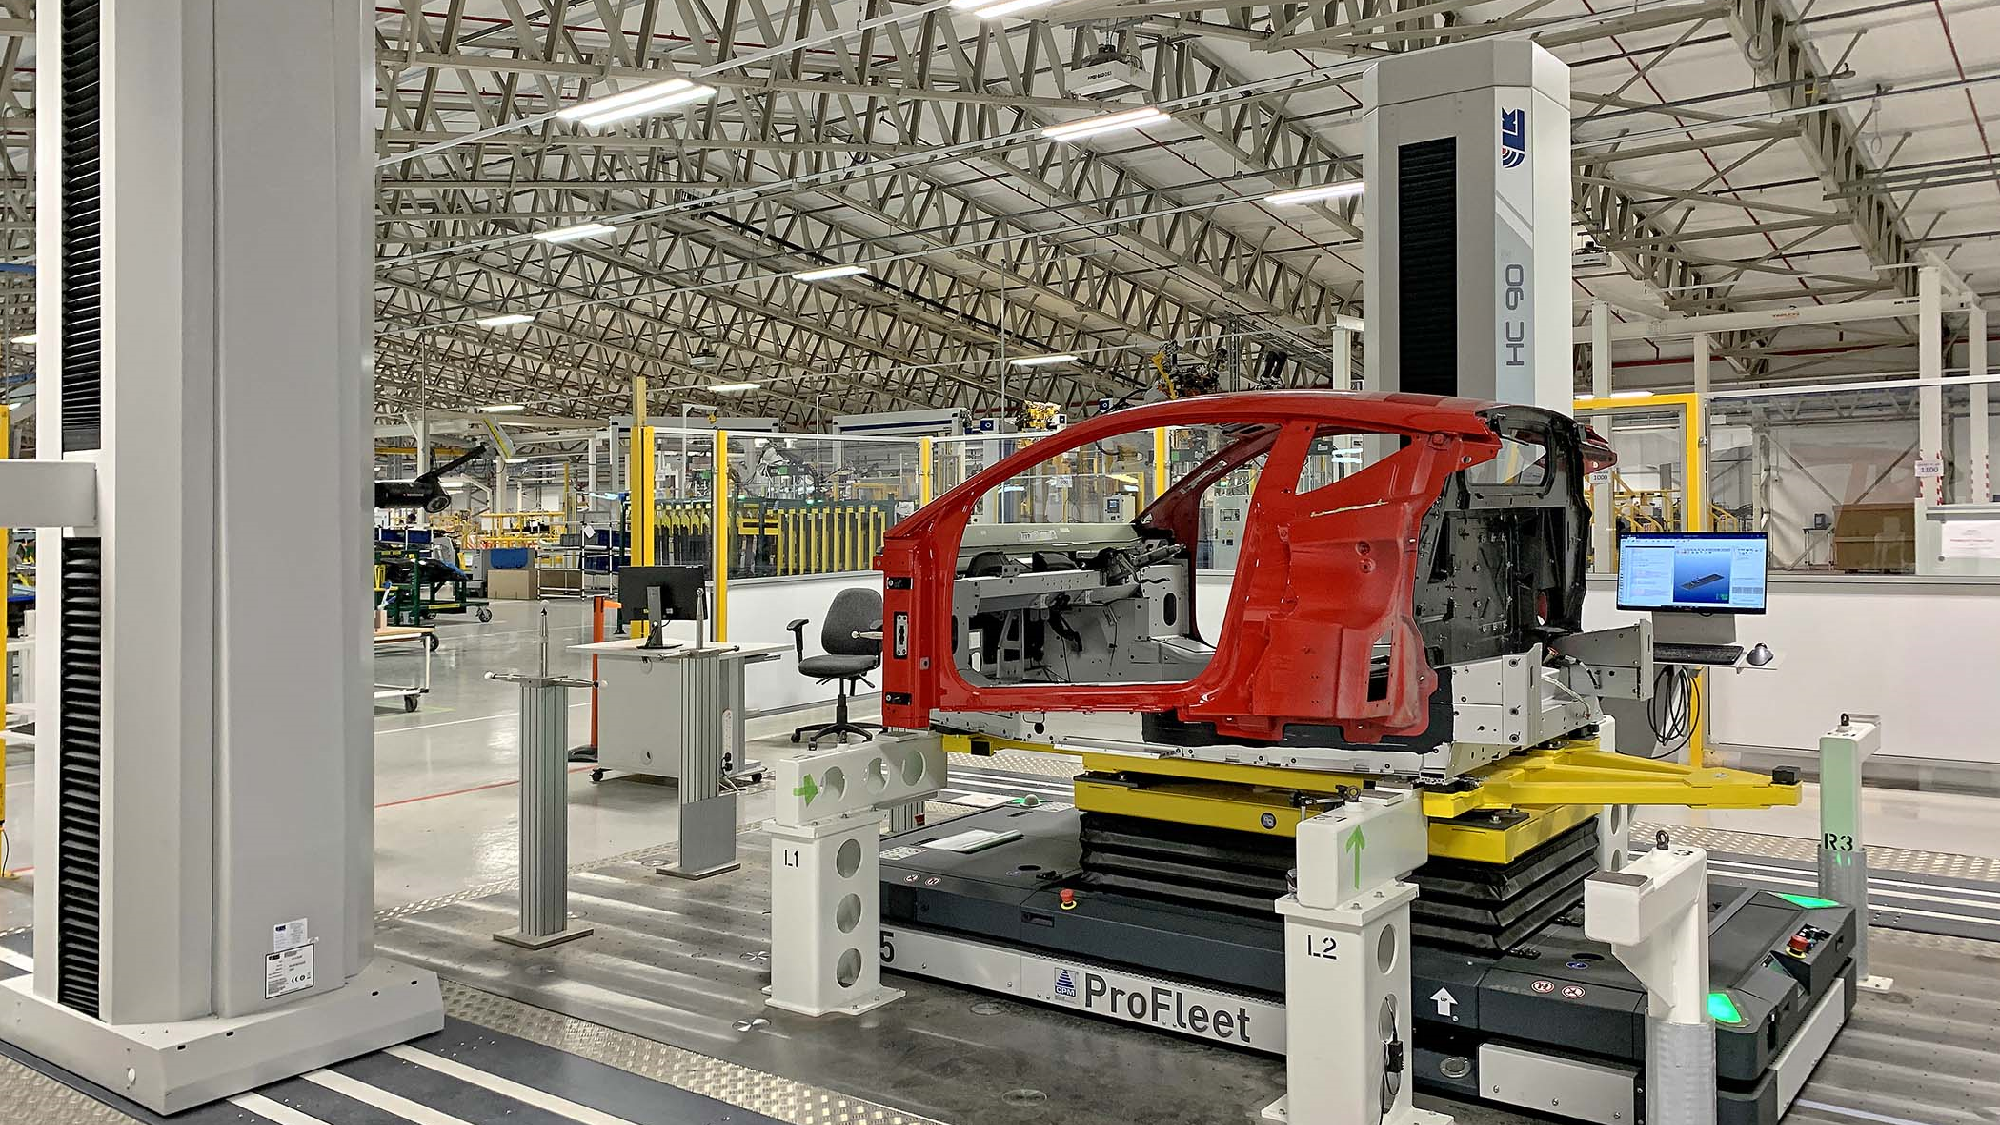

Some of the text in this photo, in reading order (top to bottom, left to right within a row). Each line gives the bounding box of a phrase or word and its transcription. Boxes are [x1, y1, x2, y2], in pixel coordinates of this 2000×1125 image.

[1505, 264, 1525, 366] HC 90
[1824, 833, 1852, 851] R3
[785, 850, 799, 867] L1
[1307, 934, 1337, 960] L2
[1056, 986, 1075, 997] CPM
[1085, 973, 1250, 1043] ProFleet
